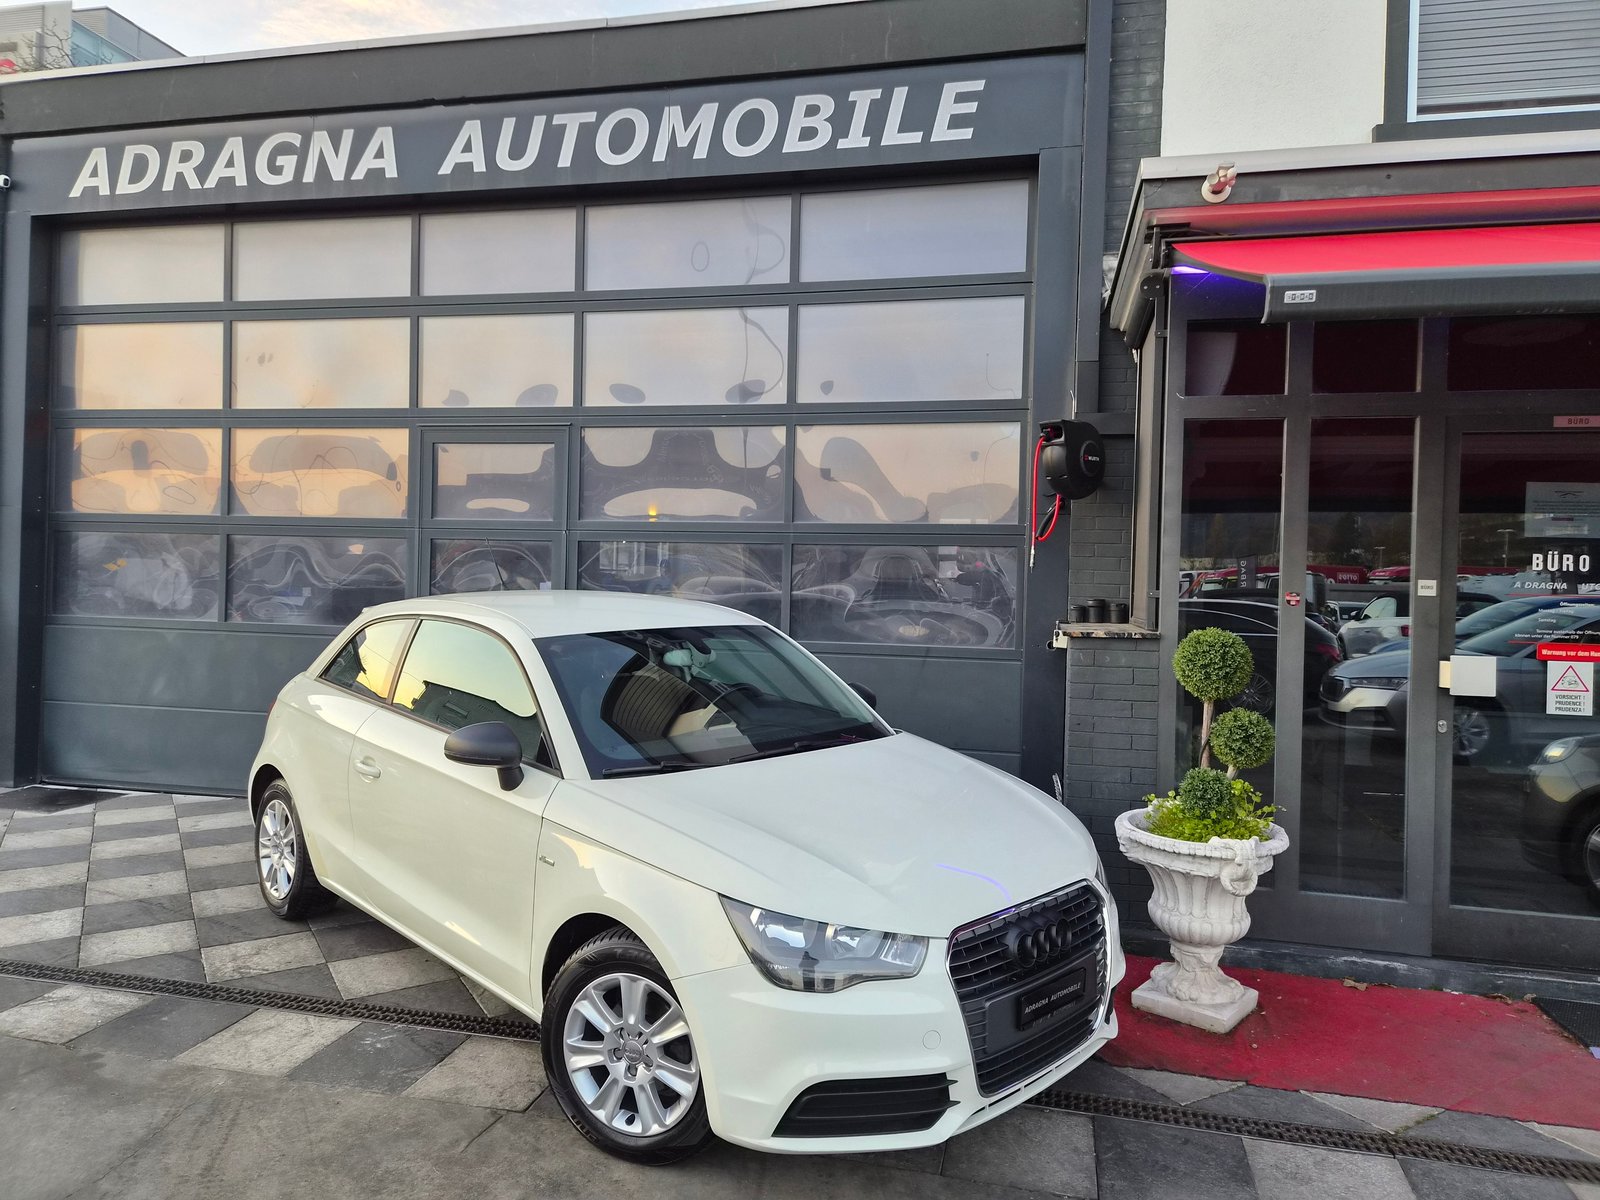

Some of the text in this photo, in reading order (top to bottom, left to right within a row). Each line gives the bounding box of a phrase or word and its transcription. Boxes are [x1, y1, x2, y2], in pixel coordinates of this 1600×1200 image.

[68, 79, 986, 198] ADRAGNA AUTOMOBILE
[1567, 417, 1590, 425] BÜRO
[1532, 551, 1590, 572] BÜRO
[1524, 581, 1568, 590] DRAGNA
[1541, 649, 1566, 657] Warnung
[1024, 997, 1048, 1014] ADRAGNA
[1050, 982, 1081, 1001] AUTOMOBILE
